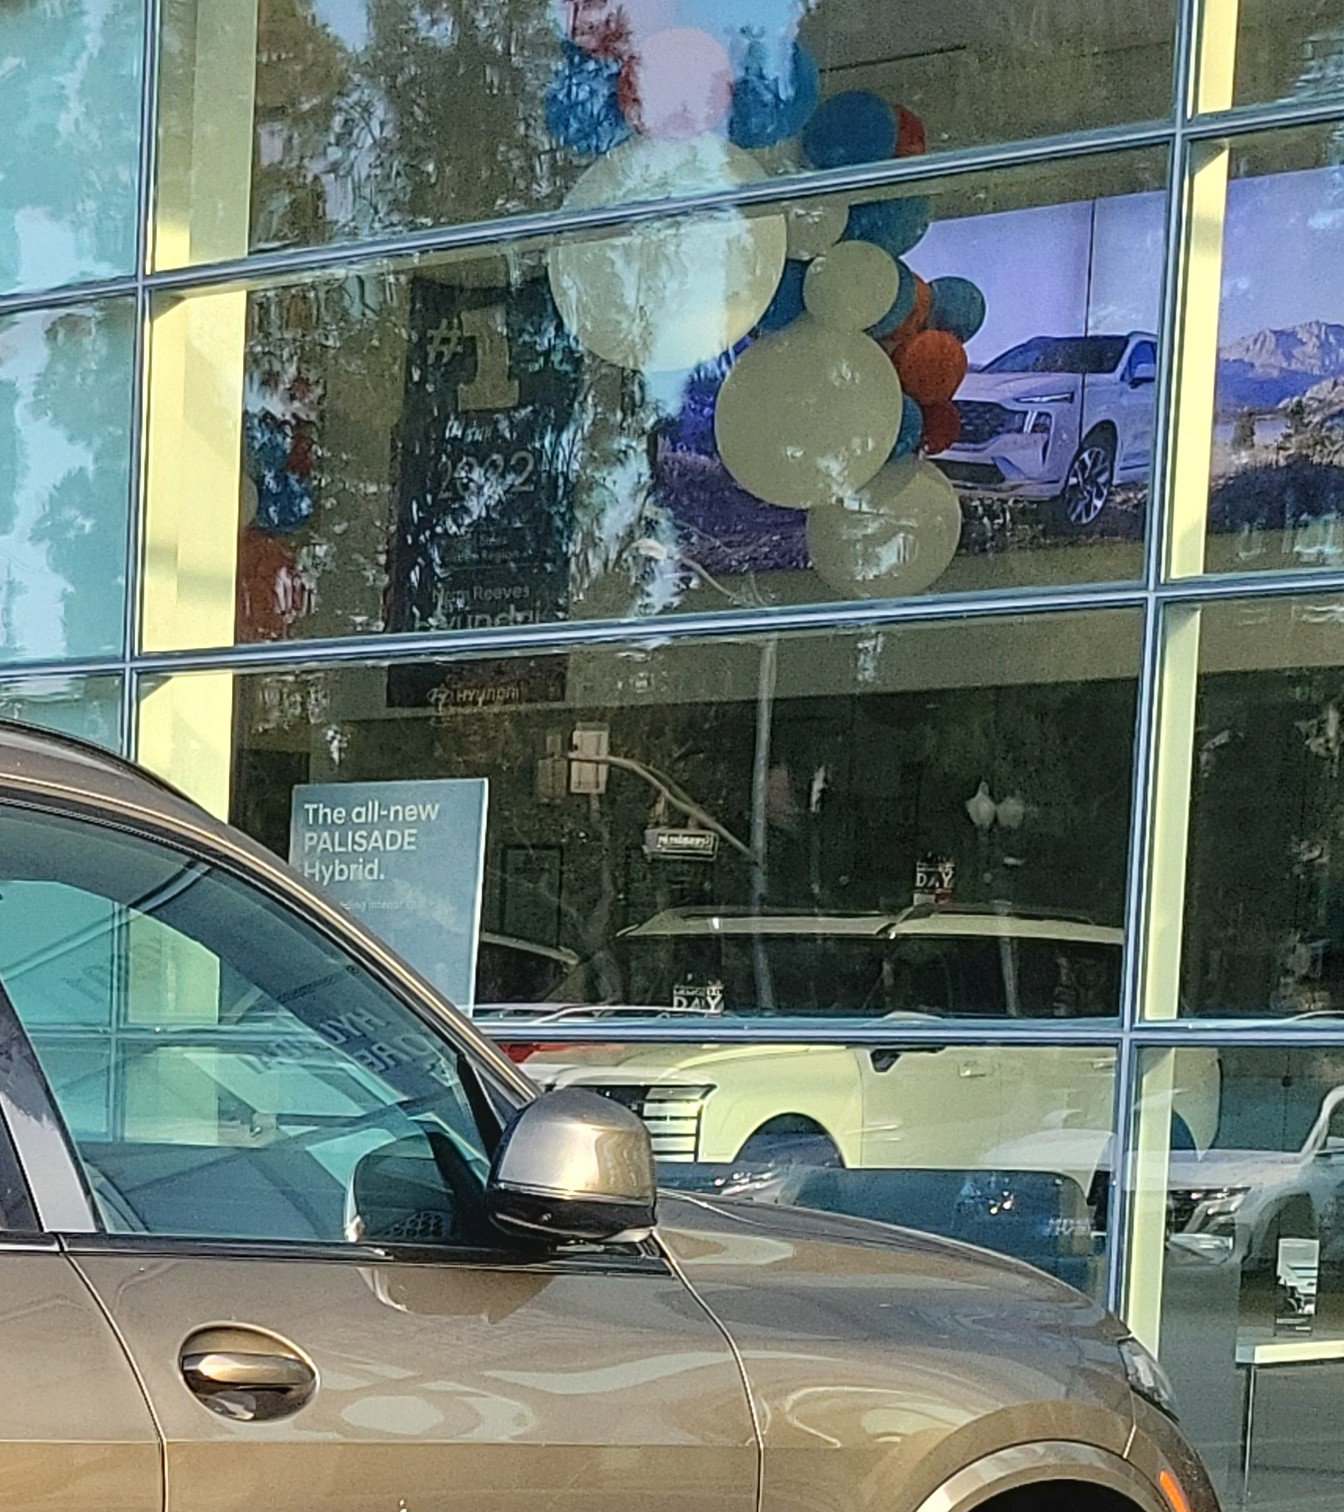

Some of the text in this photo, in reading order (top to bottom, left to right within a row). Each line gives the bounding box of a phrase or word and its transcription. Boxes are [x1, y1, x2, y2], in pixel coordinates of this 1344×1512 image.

[304, 800, 440, 825] The all-new
[304, 829, 418, 853] PALISADE
[304, 857, 385, 885] Hybrid.
